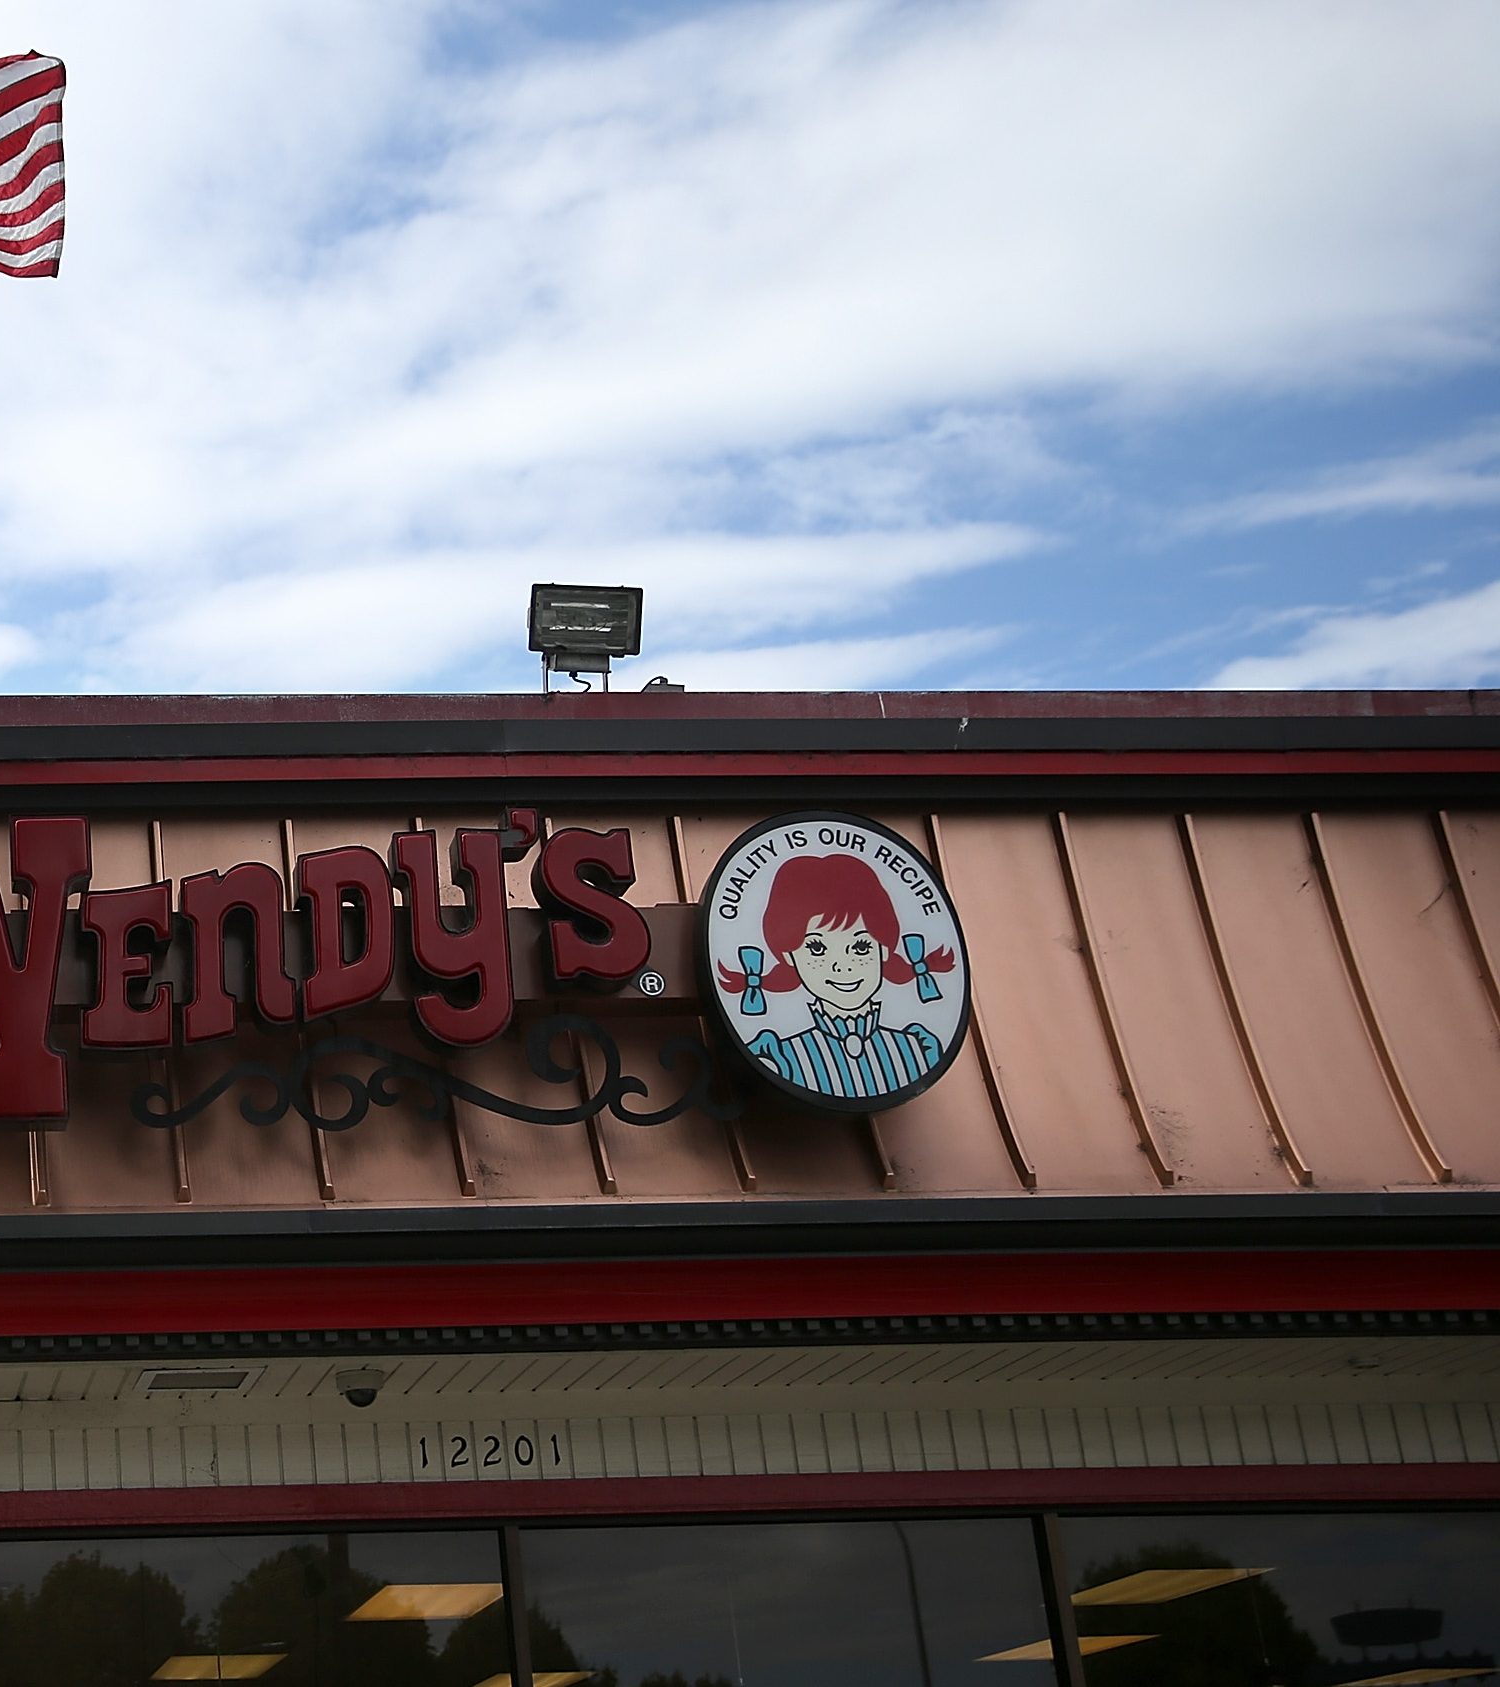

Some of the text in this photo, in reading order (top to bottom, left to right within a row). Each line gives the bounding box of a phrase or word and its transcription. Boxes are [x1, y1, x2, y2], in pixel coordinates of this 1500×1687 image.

[719, 828, 941, 920] QUALITY IS OUR RECIPE
[419, 1433, 561, 1469] 12201
